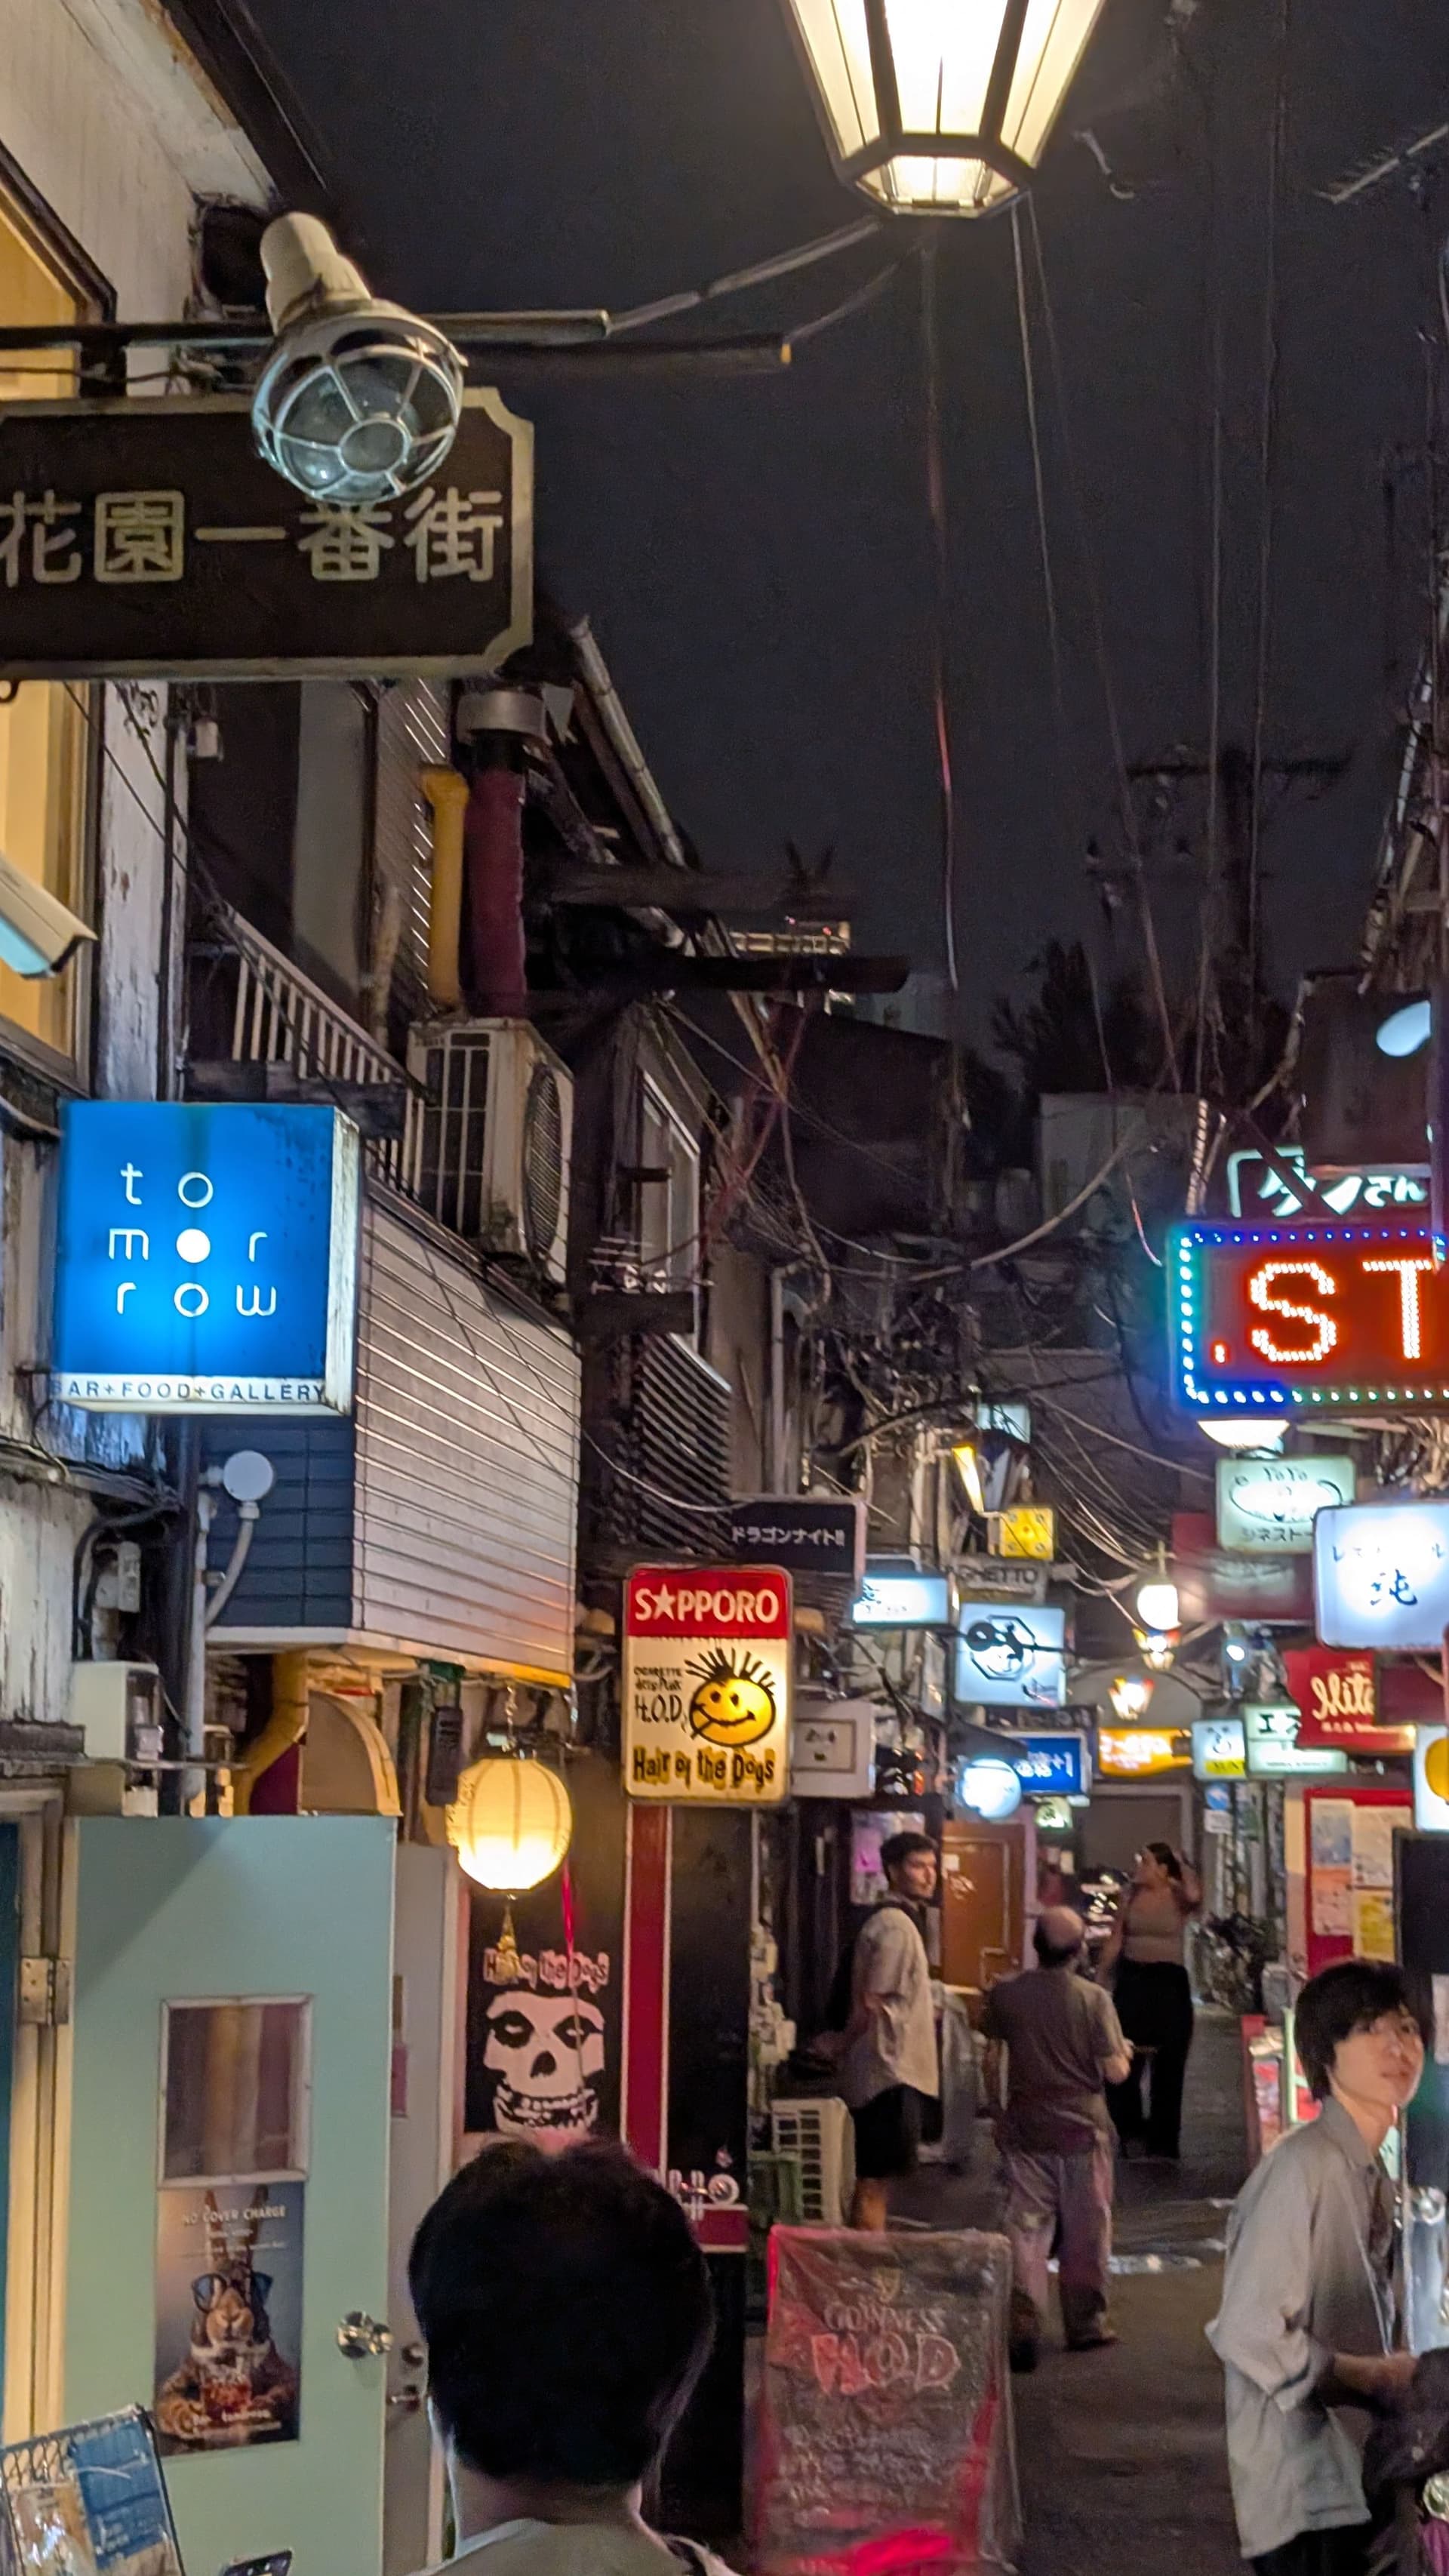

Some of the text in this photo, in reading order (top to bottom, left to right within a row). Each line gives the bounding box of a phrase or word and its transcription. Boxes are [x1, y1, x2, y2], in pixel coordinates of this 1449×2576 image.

[0, 487, 503, 587] 花園一番街
[633, 1746, 671, 1783] Hair
[697, 1747, 727, 1784] the
[732, 1750, 775, 1792] Dogs
